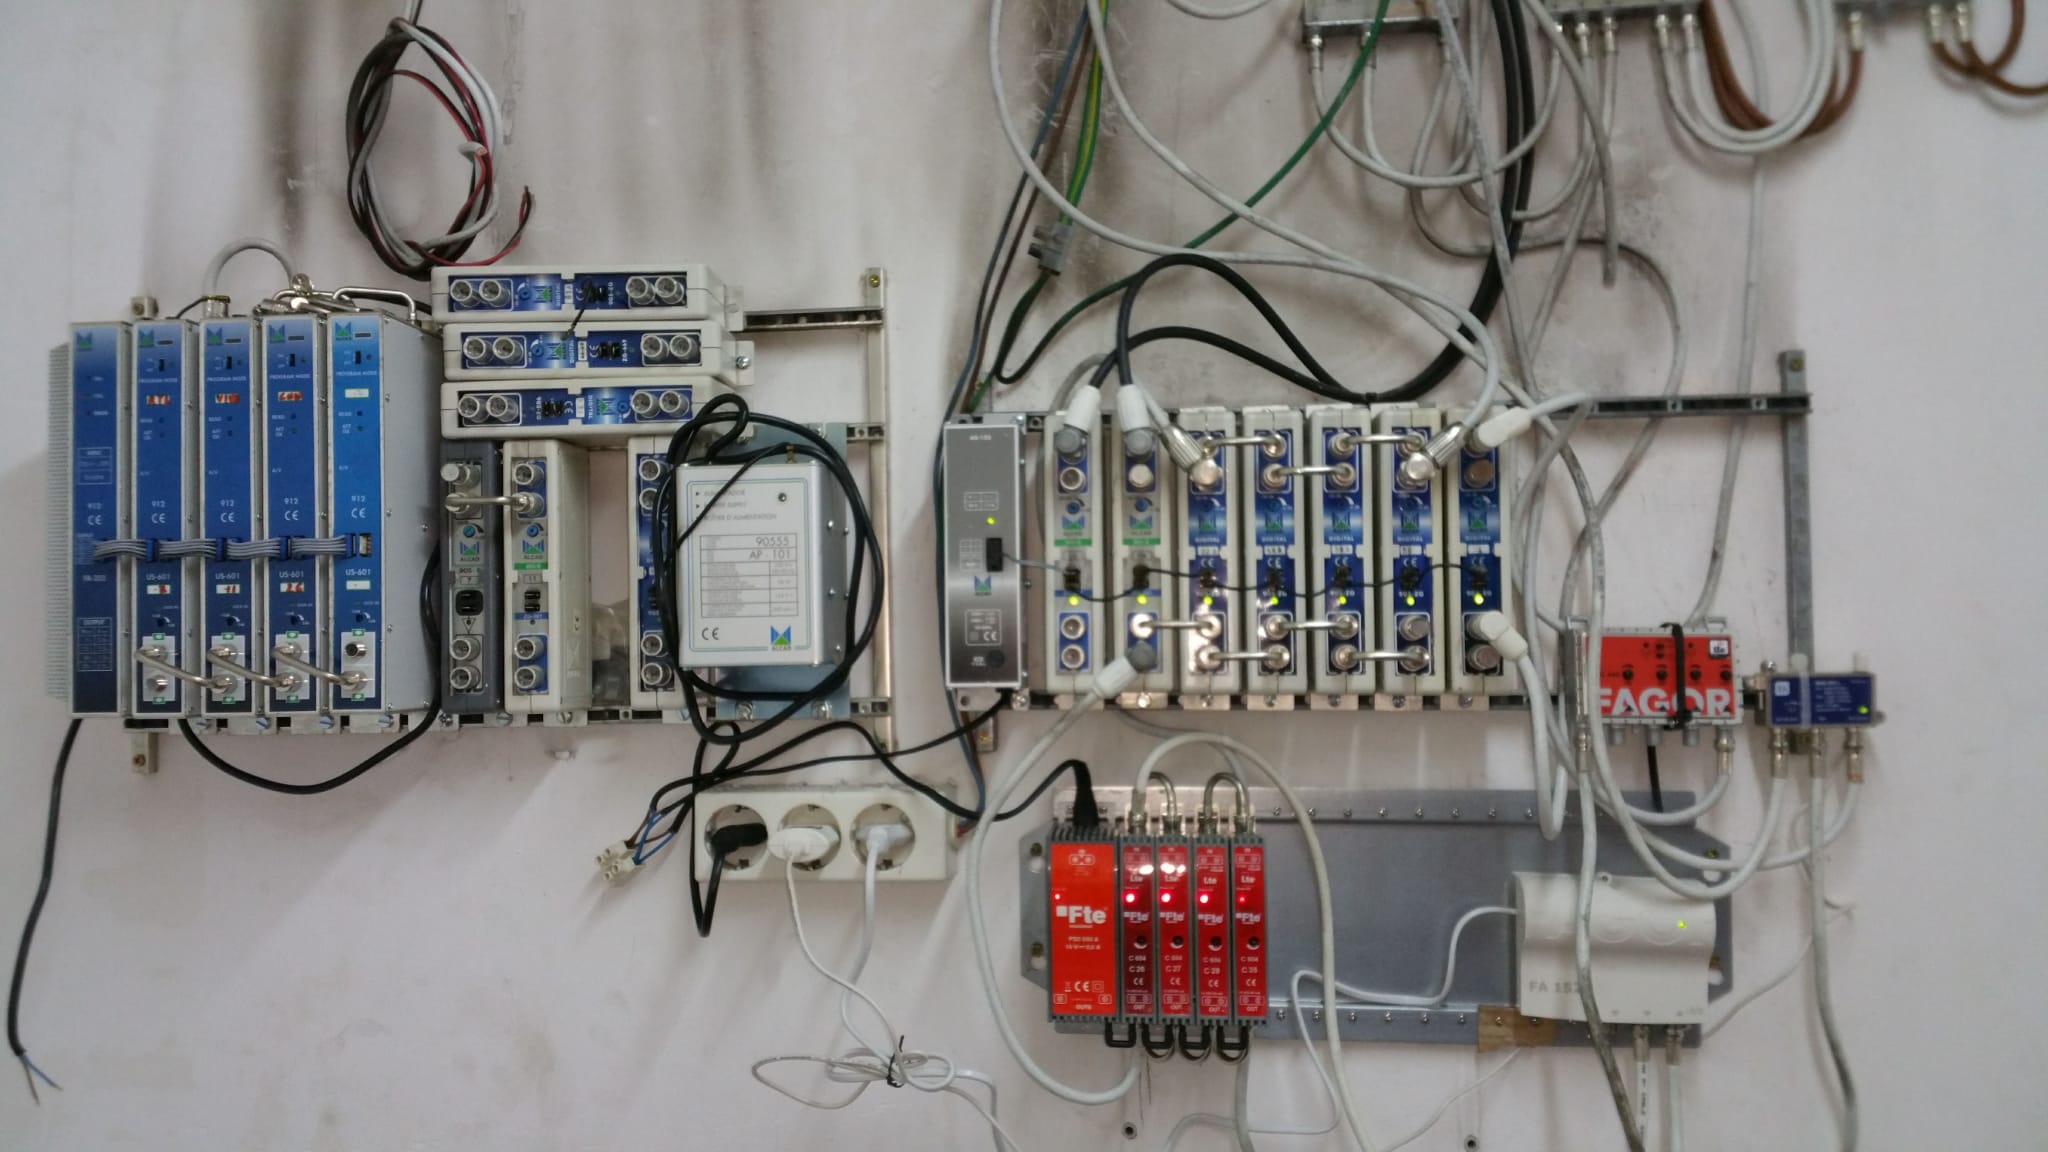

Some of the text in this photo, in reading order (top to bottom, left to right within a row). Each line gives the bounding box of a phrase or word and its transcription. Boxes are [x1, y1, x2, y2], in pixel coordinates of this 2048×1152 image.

[756, 536, 790, 547] 90555
[749, 550, 762, 560] AP
[772, 550, 791, 559] 101
[279, 570, 304, 578] US-601
[702, 627, 720, 640] CE
[1068, 905, 1107, 924] Fte
[1074, 980, 1090, 992] CE
[1529, 980, 1548, 992] FA
